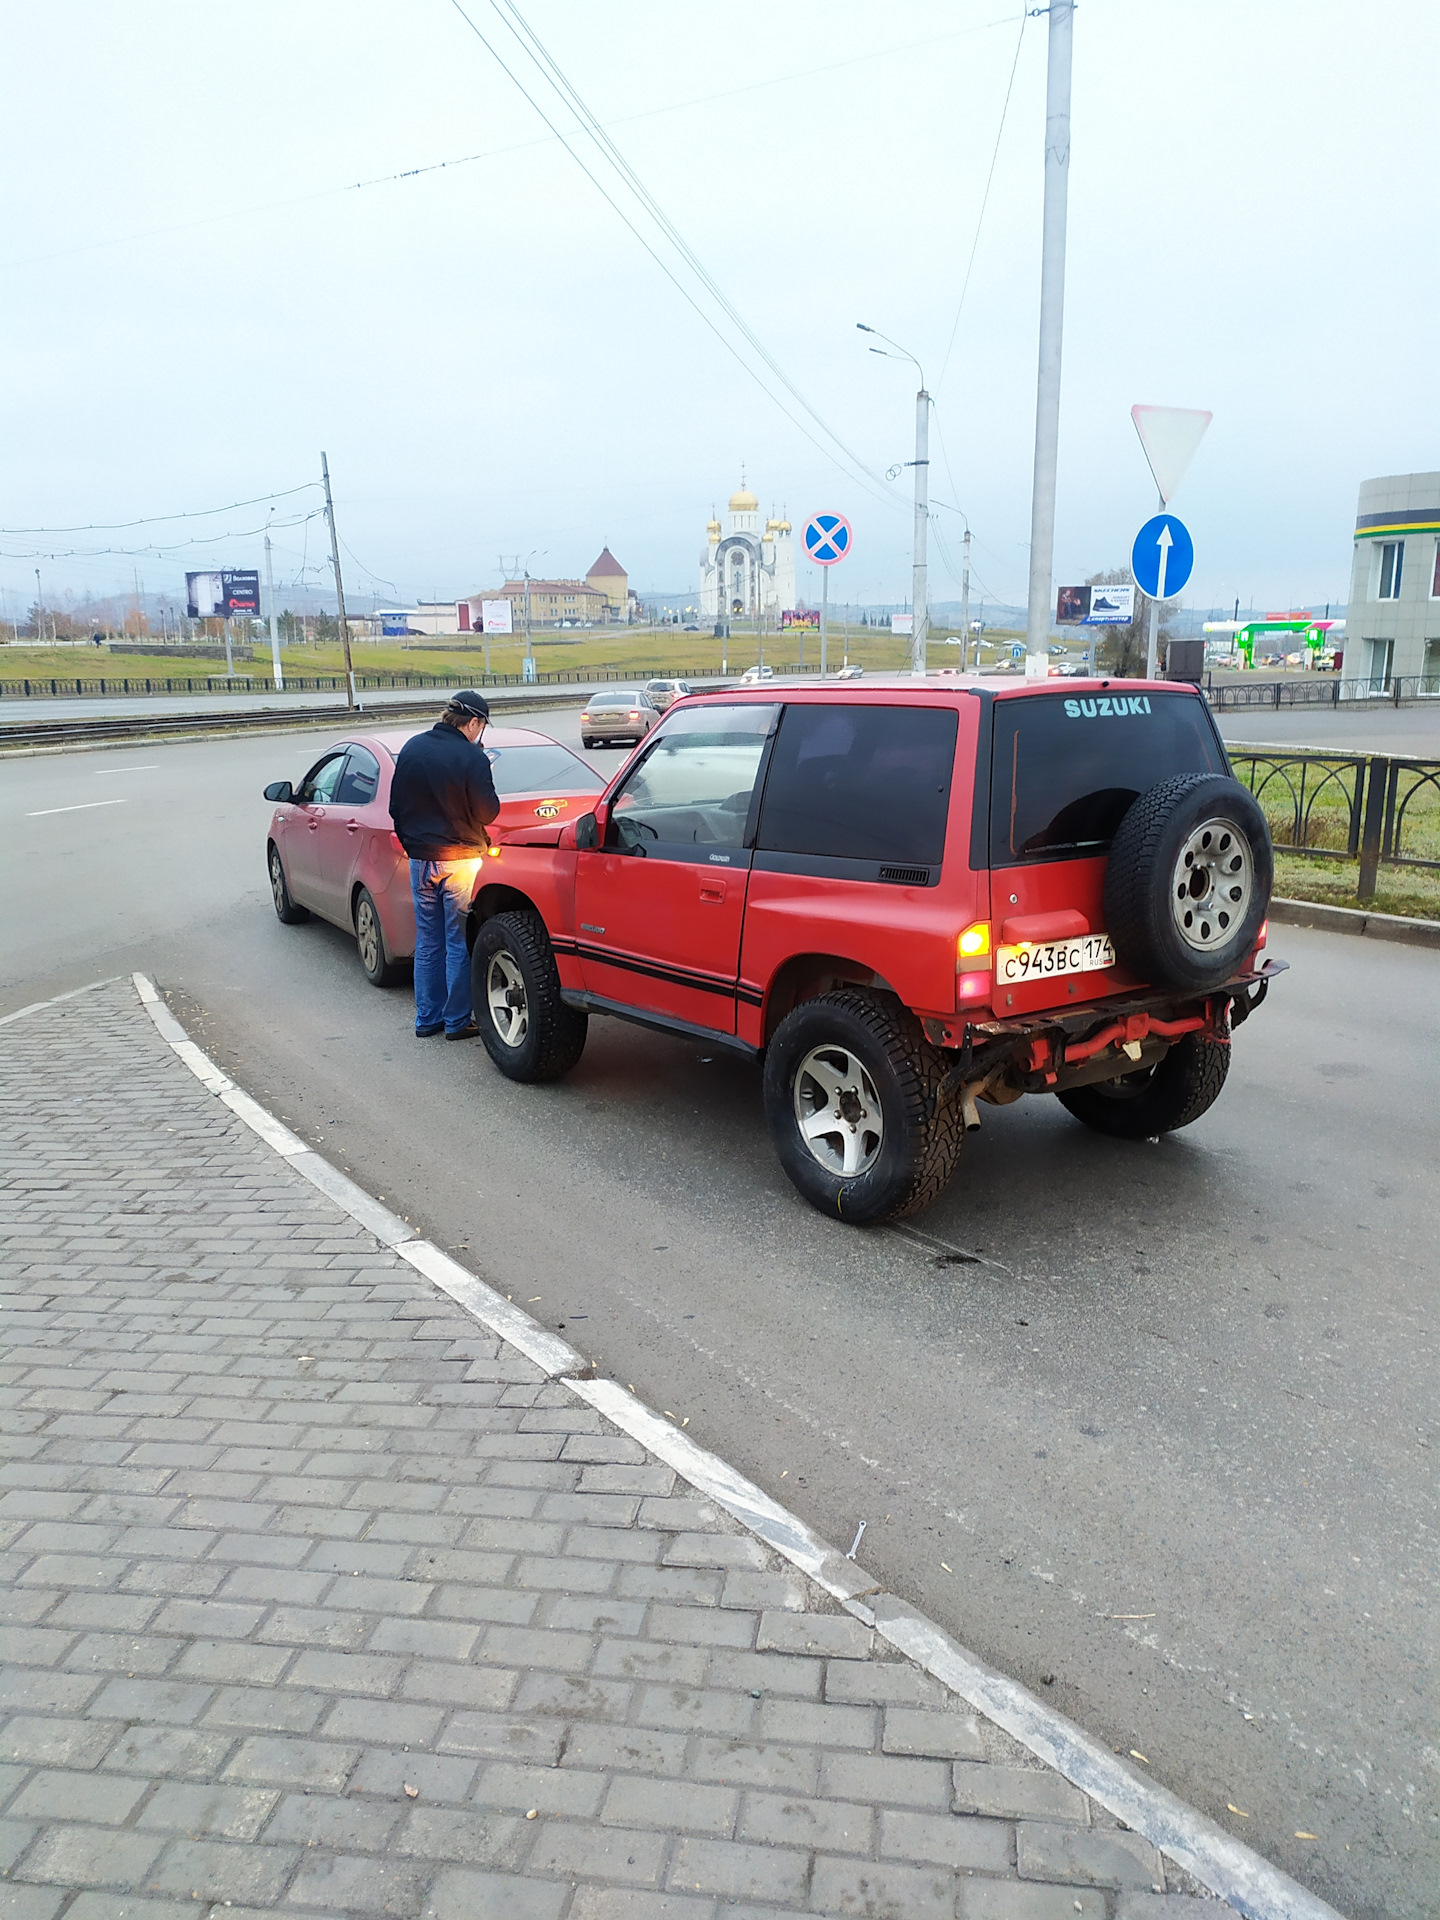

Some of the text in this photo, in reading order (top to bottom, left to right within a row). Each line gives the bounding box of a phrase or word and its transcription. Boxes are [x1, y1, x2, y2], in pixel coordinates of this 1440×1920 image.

[1063, 696, 1152, 718] SUZUKI
[539, 808, 557, 817] KIA
[1085, 936, 1112, 959] 174
[1089, 958, 1104, 967] RUS
